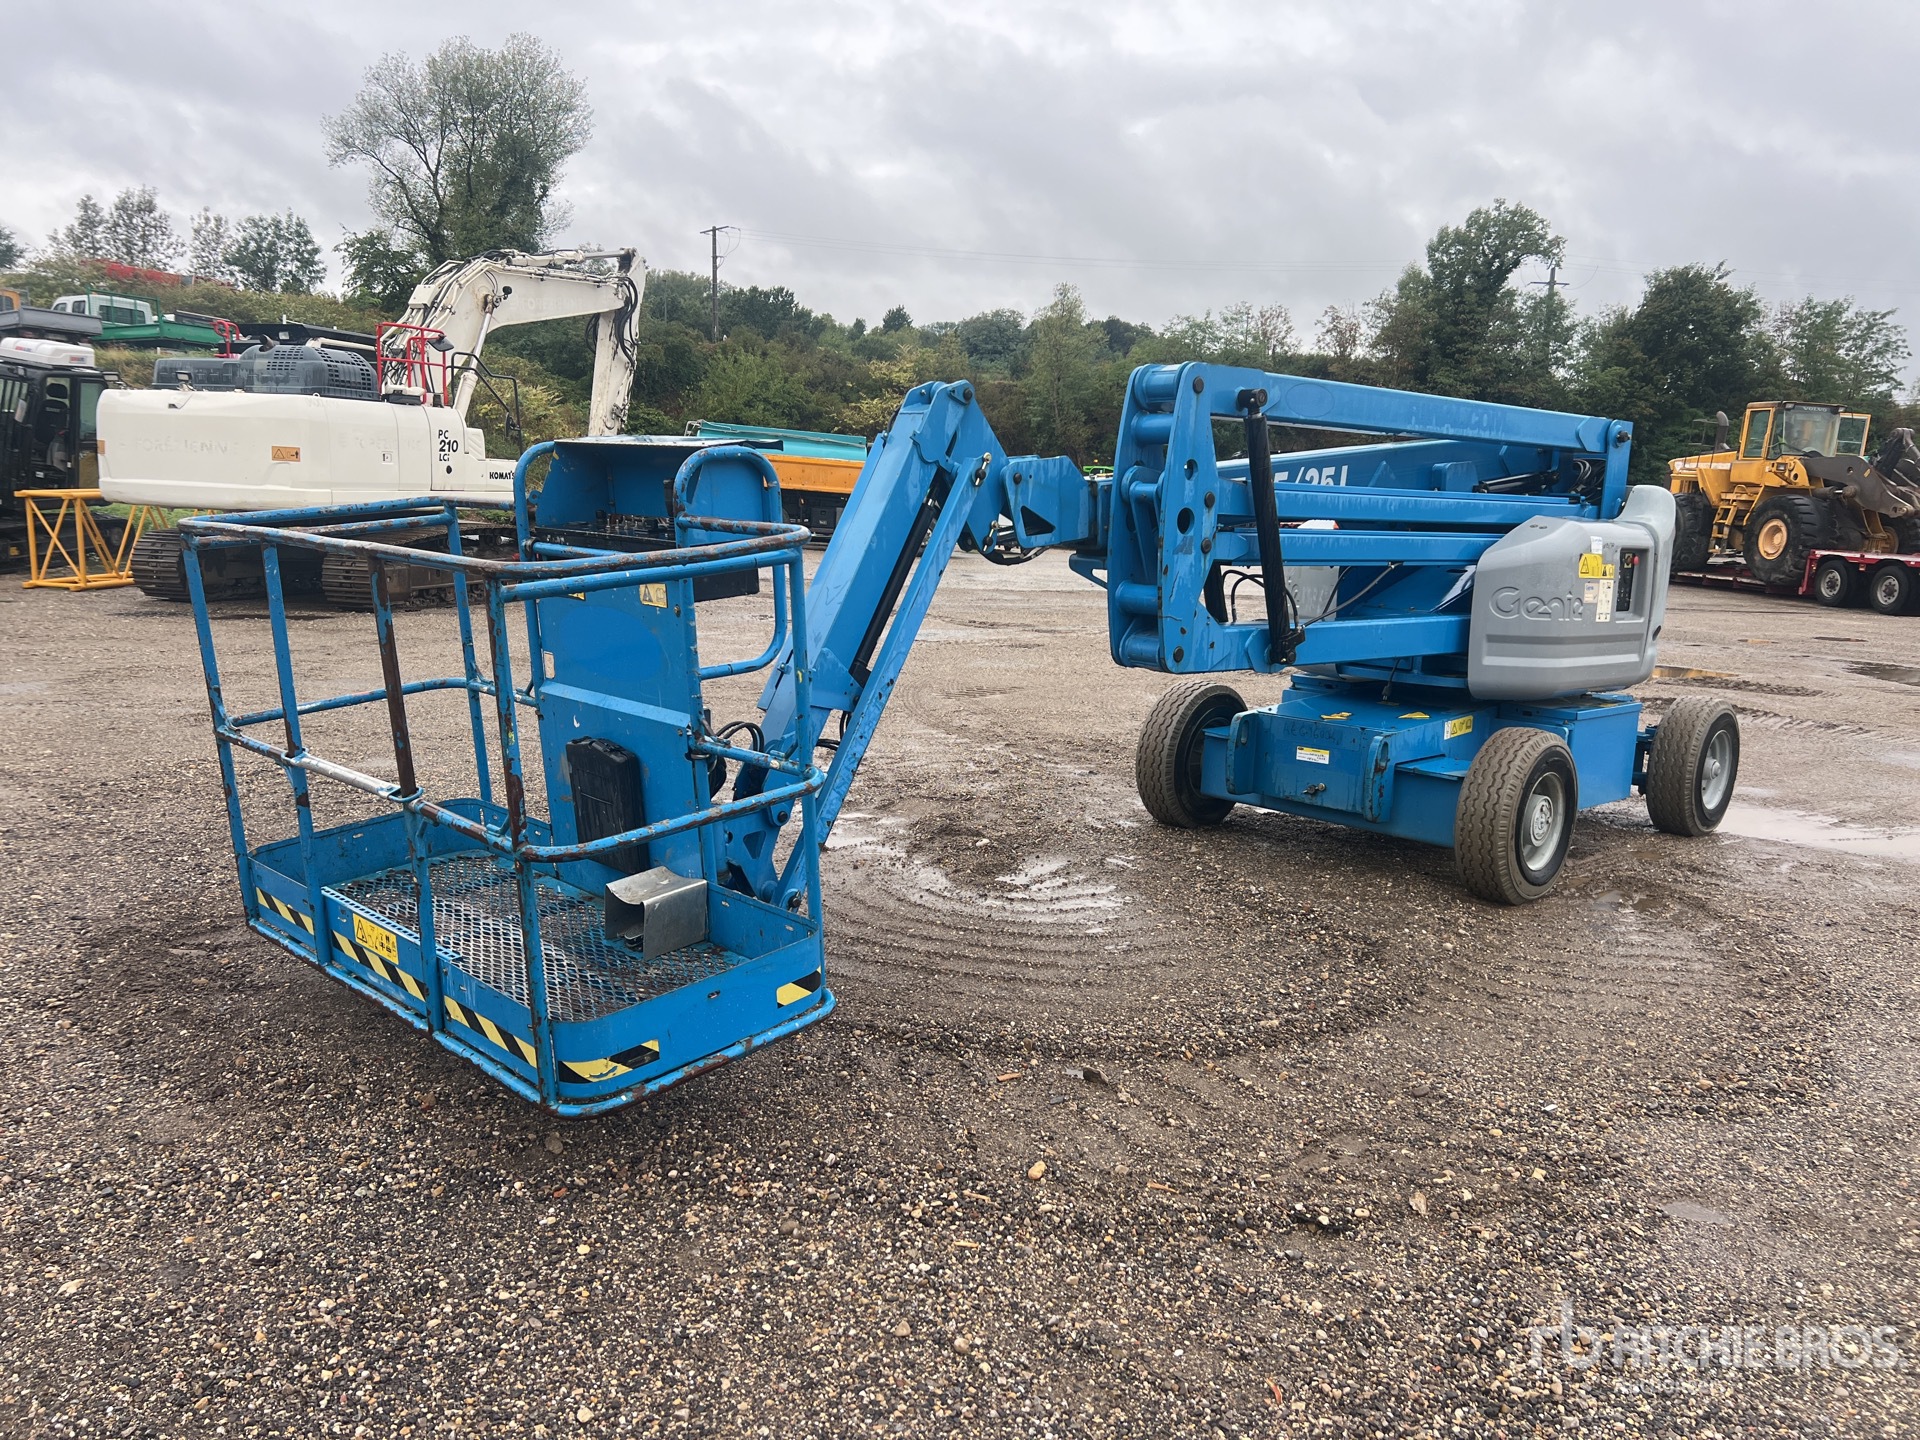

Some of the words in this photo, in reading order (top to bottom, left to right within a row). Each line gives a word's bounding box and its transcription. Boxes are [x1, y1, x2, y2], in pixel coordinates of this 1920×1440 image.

[438, 429, 448, 440] PC
[439, 439, 459, 453] 210
[489, 471, 516, 480] KOMATS
[1489, 586, 1584, 621] Genie
